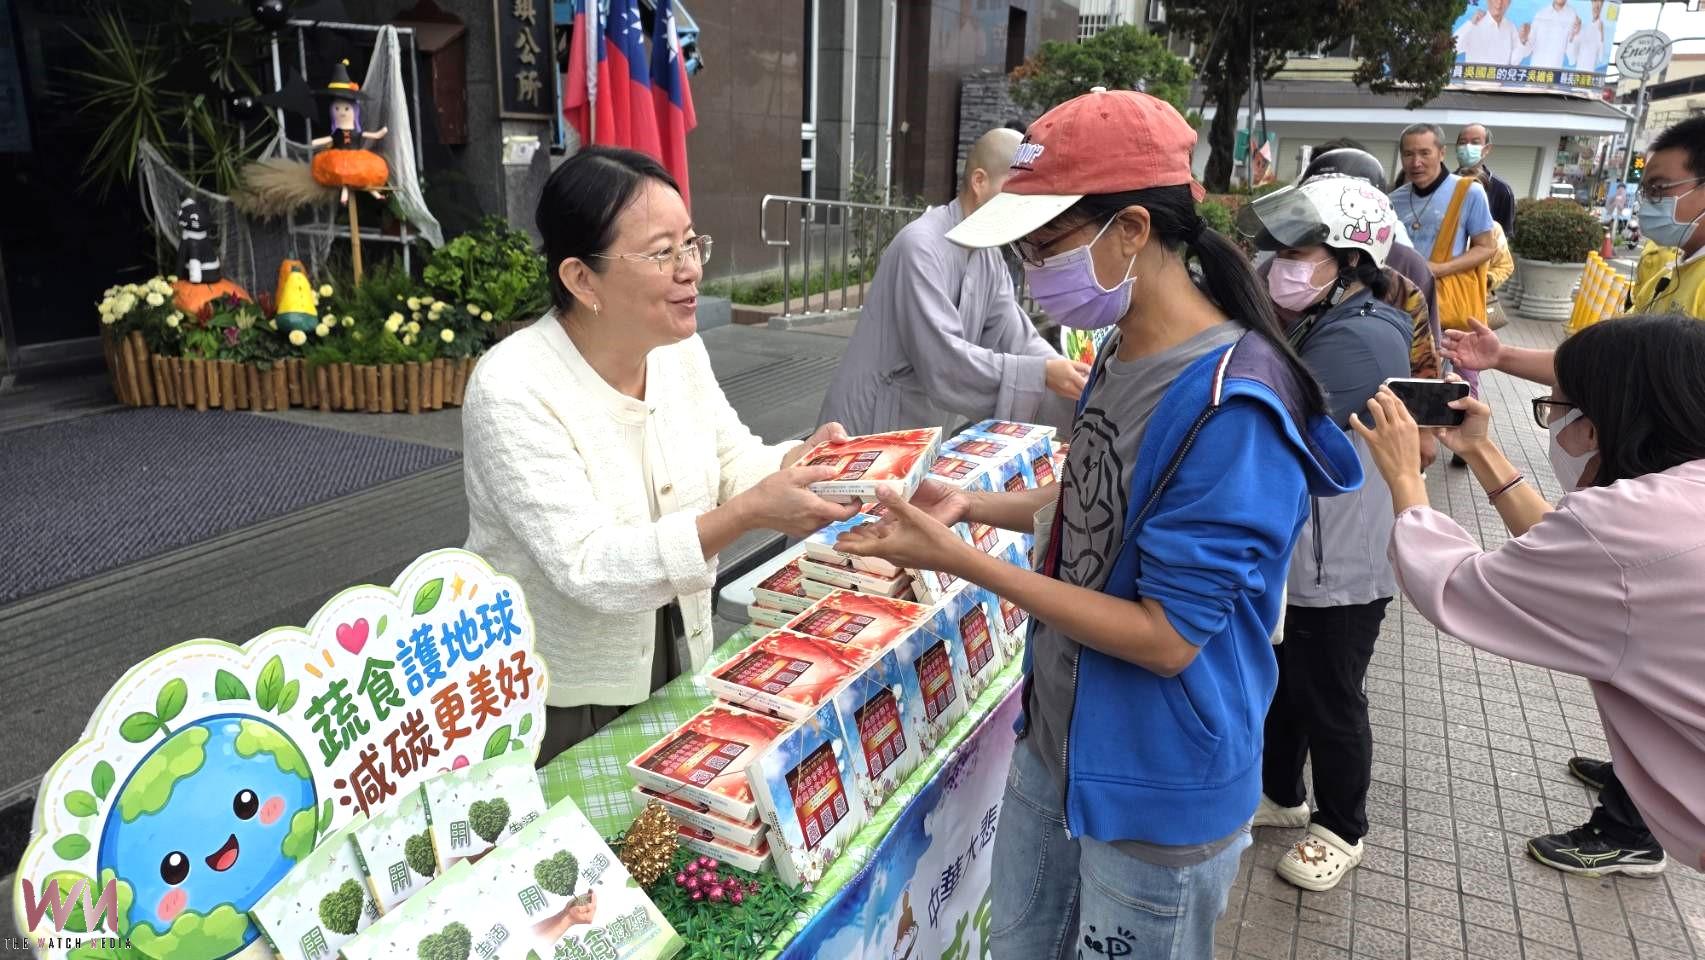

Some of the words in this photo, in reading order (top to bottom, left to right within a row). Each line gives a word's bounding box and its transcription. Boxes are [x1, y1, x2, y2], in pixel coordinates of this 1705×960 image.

[304, 589, 523, 767] 蔬食護地球
[333, 650, 534, 818] 減碳更美好
[928, 803, 999, 929] 中華大悲
